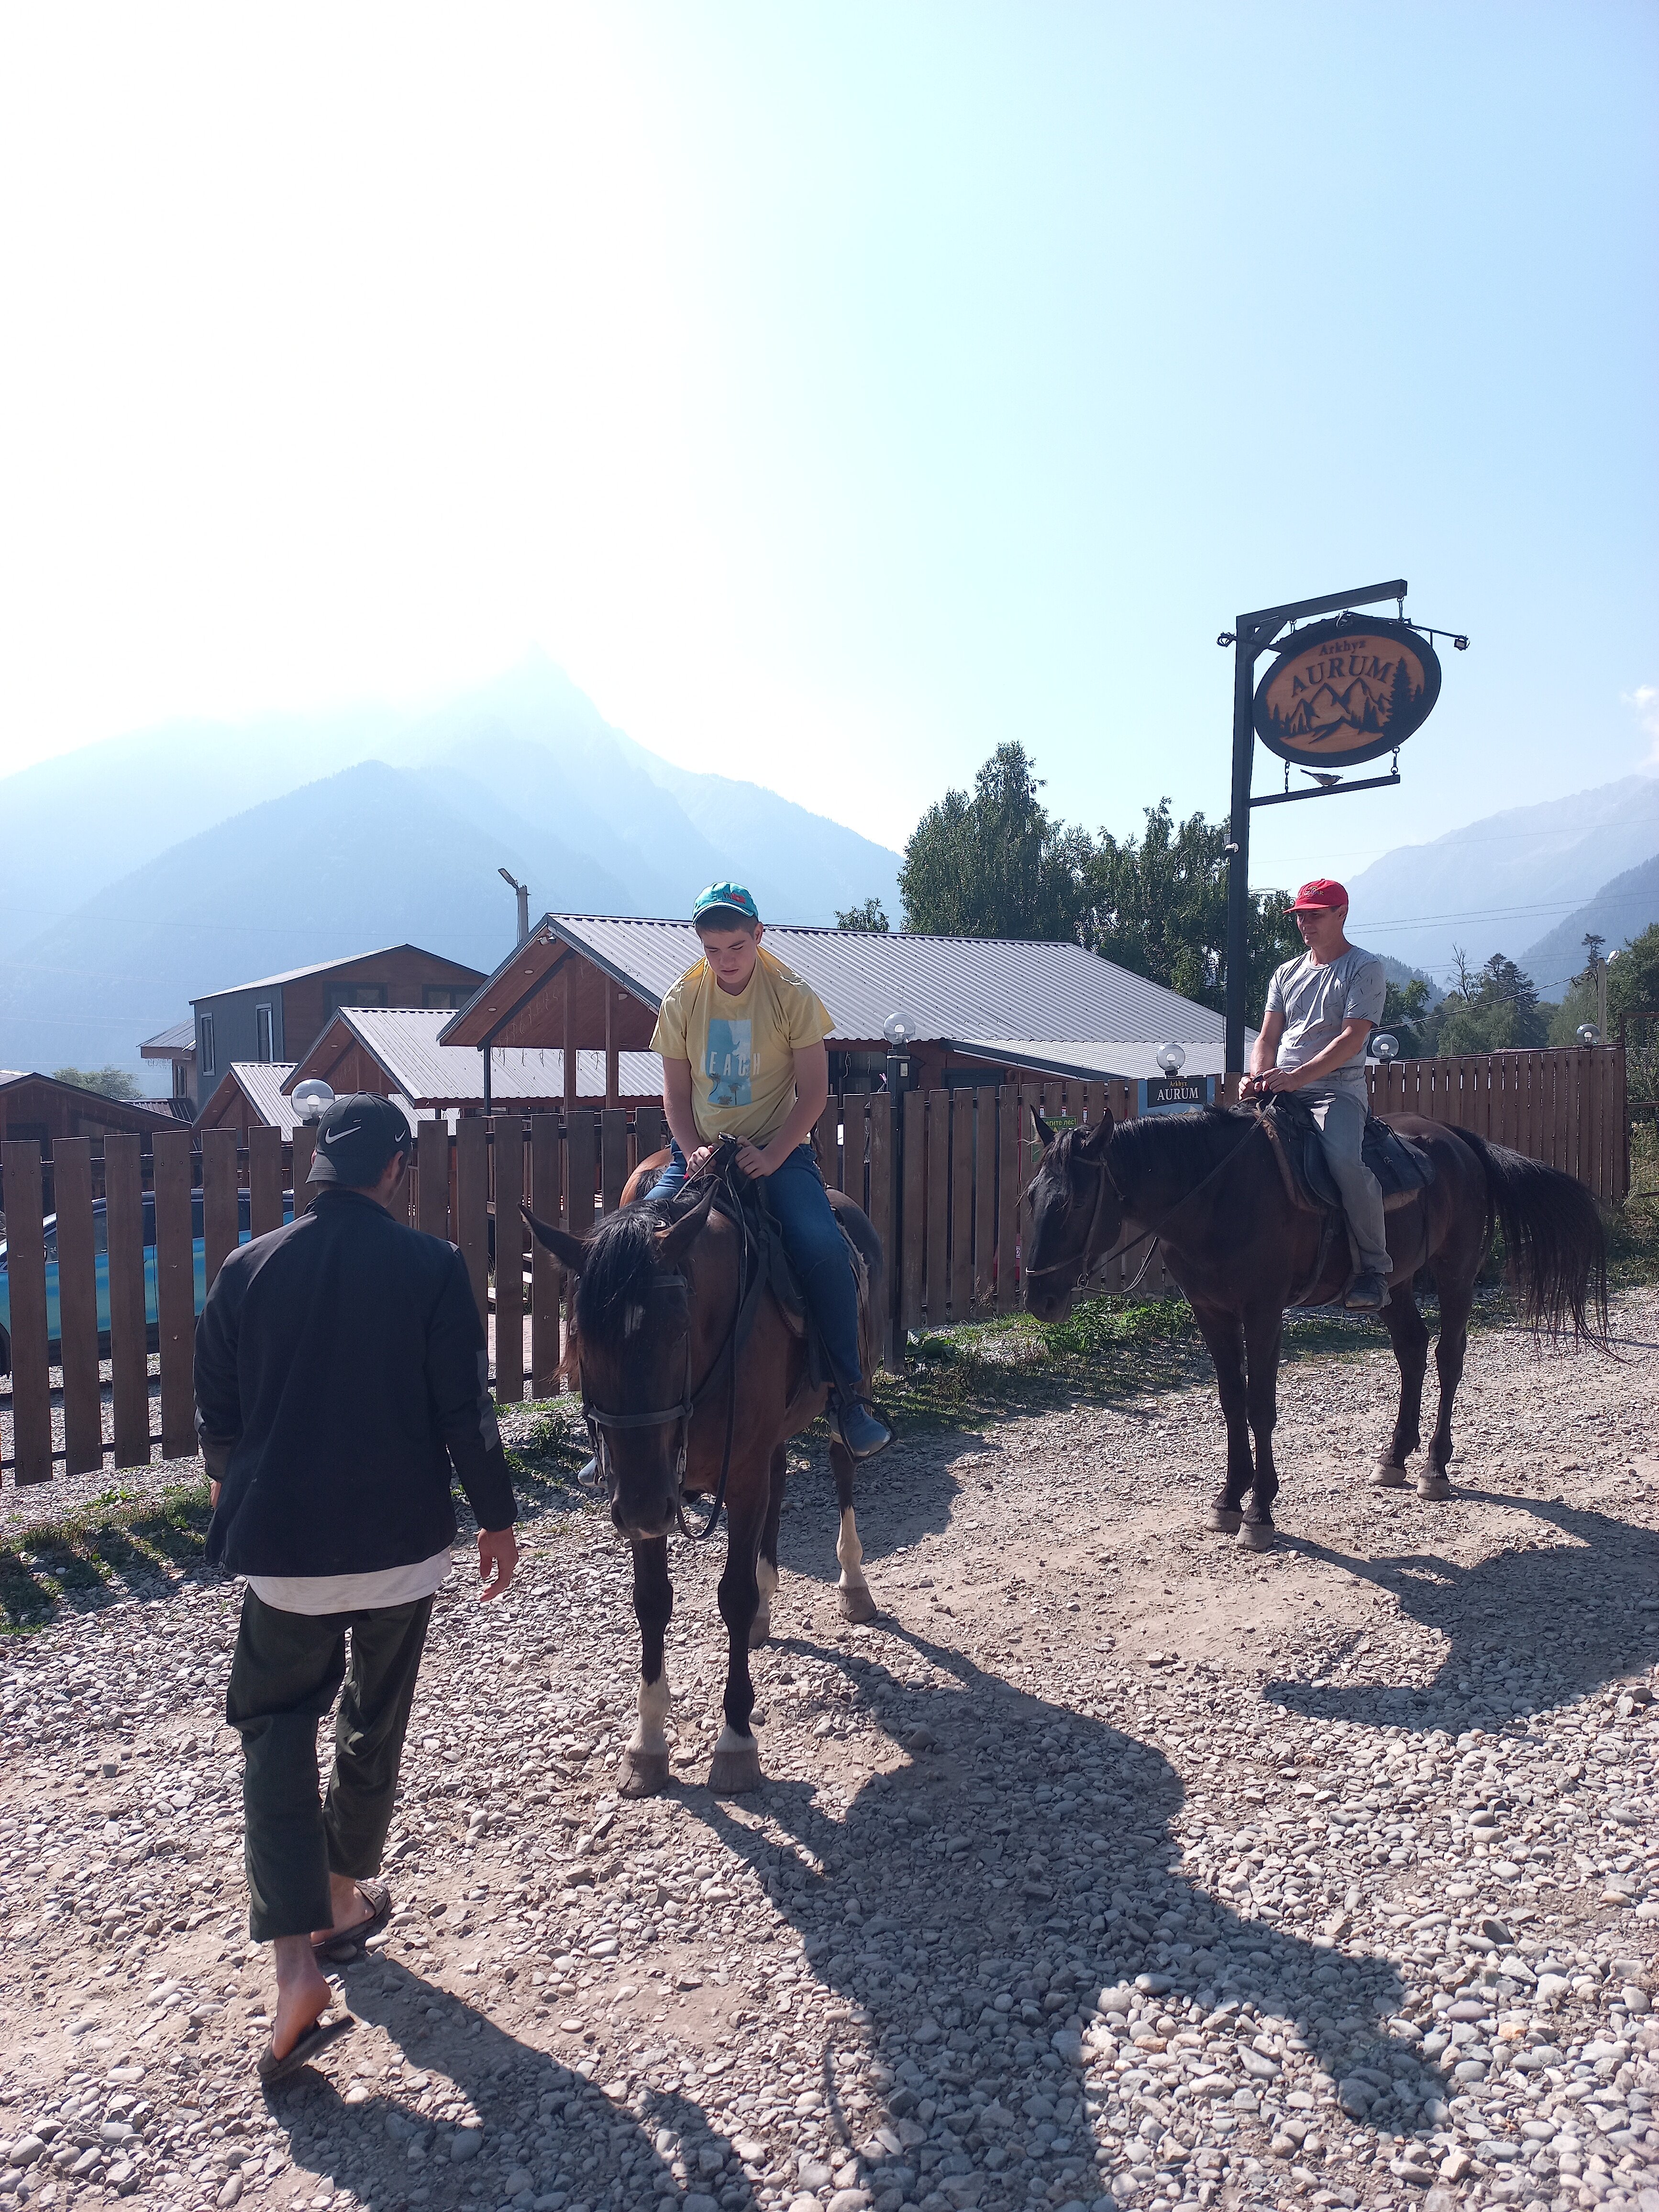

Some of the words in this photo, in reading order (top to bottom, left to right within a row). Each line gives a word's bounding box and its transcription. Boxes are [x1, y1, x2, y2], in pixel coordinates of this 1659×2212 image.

[1318, 640, 1366, 656] Arkhyz
[1291, 655, 1394, 698] AURUM
[1157, 1087, 1199, 1101] AURUM
